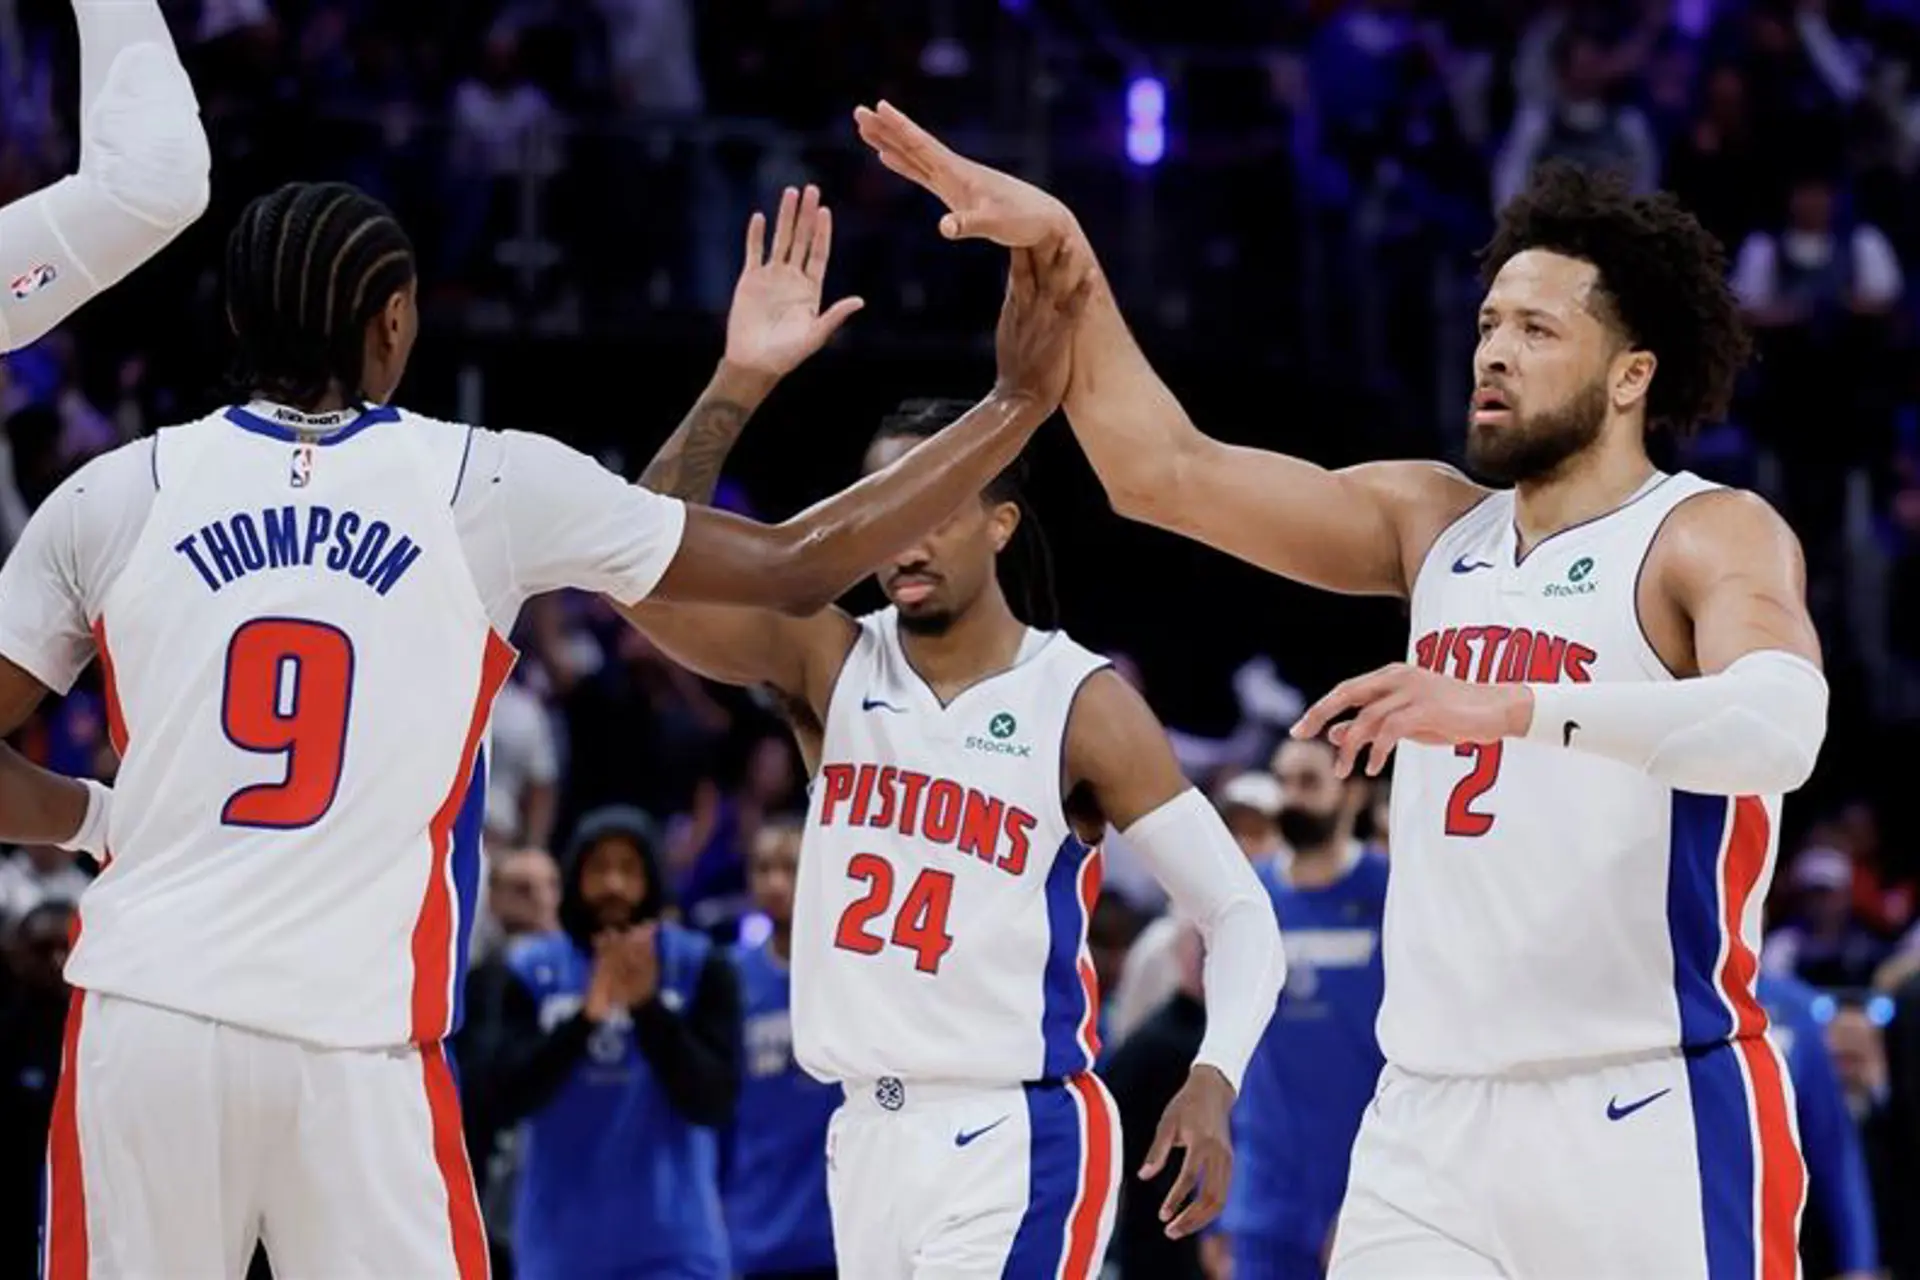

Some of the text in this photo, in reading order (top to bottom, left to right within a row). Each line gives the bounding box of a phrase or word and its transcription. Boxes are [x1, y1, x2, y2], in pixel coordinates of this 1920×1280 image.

[174, 505, 423, 597] THOMPSON
[1415, 625, 1598, 684] PISTONS
[220, 616, 356, 830] 9
[820, 763, 1038, 876] PISTONS
[1444, 738, 1504, 837] 2
[833, 852, 955, 976] 24
